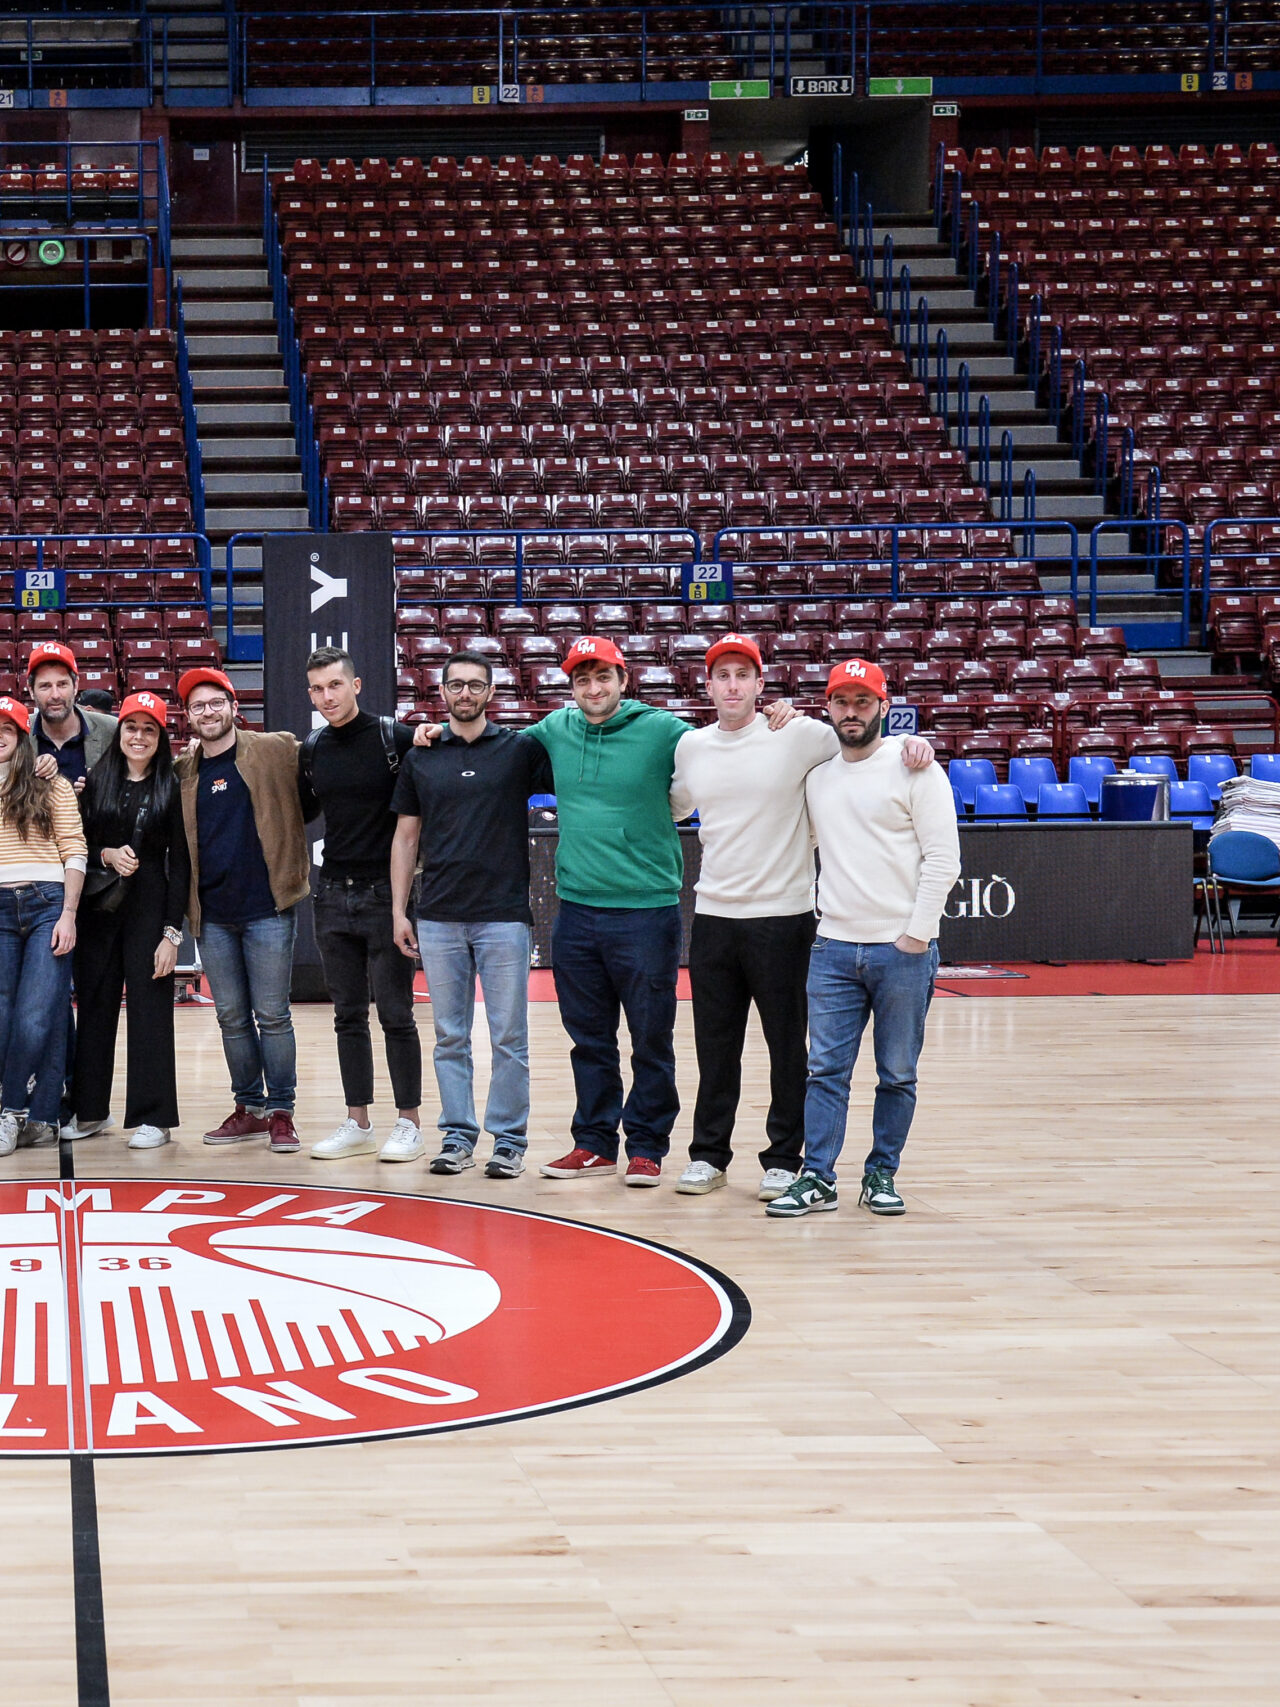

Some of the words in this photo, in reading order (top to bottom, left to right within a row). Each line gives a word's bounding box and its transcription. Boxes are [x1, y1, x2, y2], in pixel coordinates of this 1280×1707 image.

[807, 80, 838, 93] BAR
[1212, 74, 1228, 87] 23
[503, 87, 519, 99] 22
[697, 566, 718, 580] 22
[30, 573, 49, 587] 21
[693, 590, 702, 599] B
[27, 597, 35, 607] B
[890, 712, 914, 730] 22
[98, 1256, 172, 1271] 36
